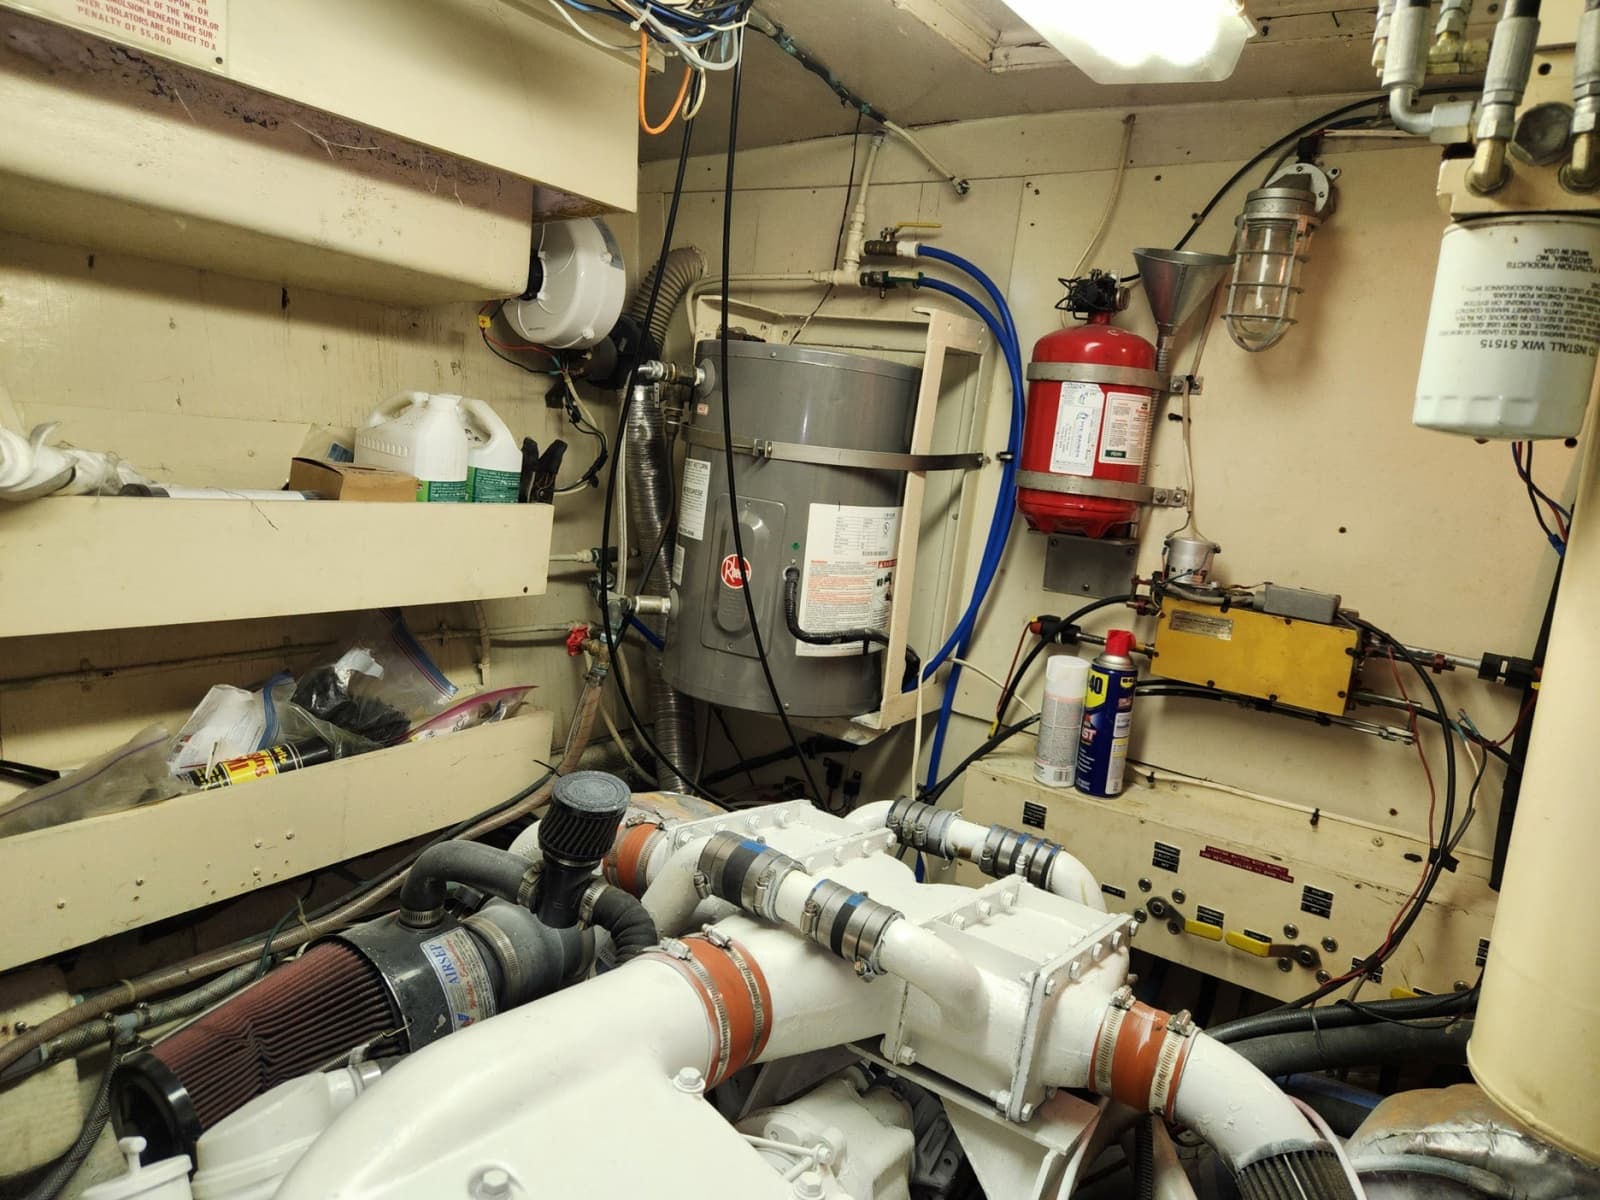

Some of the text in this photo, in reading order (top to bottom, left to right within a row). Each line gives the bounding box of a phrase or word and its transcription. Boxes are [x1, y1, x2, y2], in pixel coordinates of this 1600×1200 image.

[154, 1, 164, 10] OF
[166, 4, 179, 16] THE
[78, 6, 122, 26] PENALTY
[125, 22, 136, 32] OF
[146, 8, 180, 27] BENEATH
[182, 22, 196, 33] THE
[106, 4, 149, 26] VIOLATORS
[150, 21, 164, 32] ARE
[166, 26, 197, 44] SUBJECT
[200, 39, 210, 48] TO
[211, 44, 216, 52] A
[1506, 262, 1555, 270] PRODUCTS
[1480, 339, 1518, 349] 51515
[1522, 340, 1544, 350] WIX
[1550, 342, 1587, 355] INSTALL
[430, 944, 460, 985] AIRSEP
